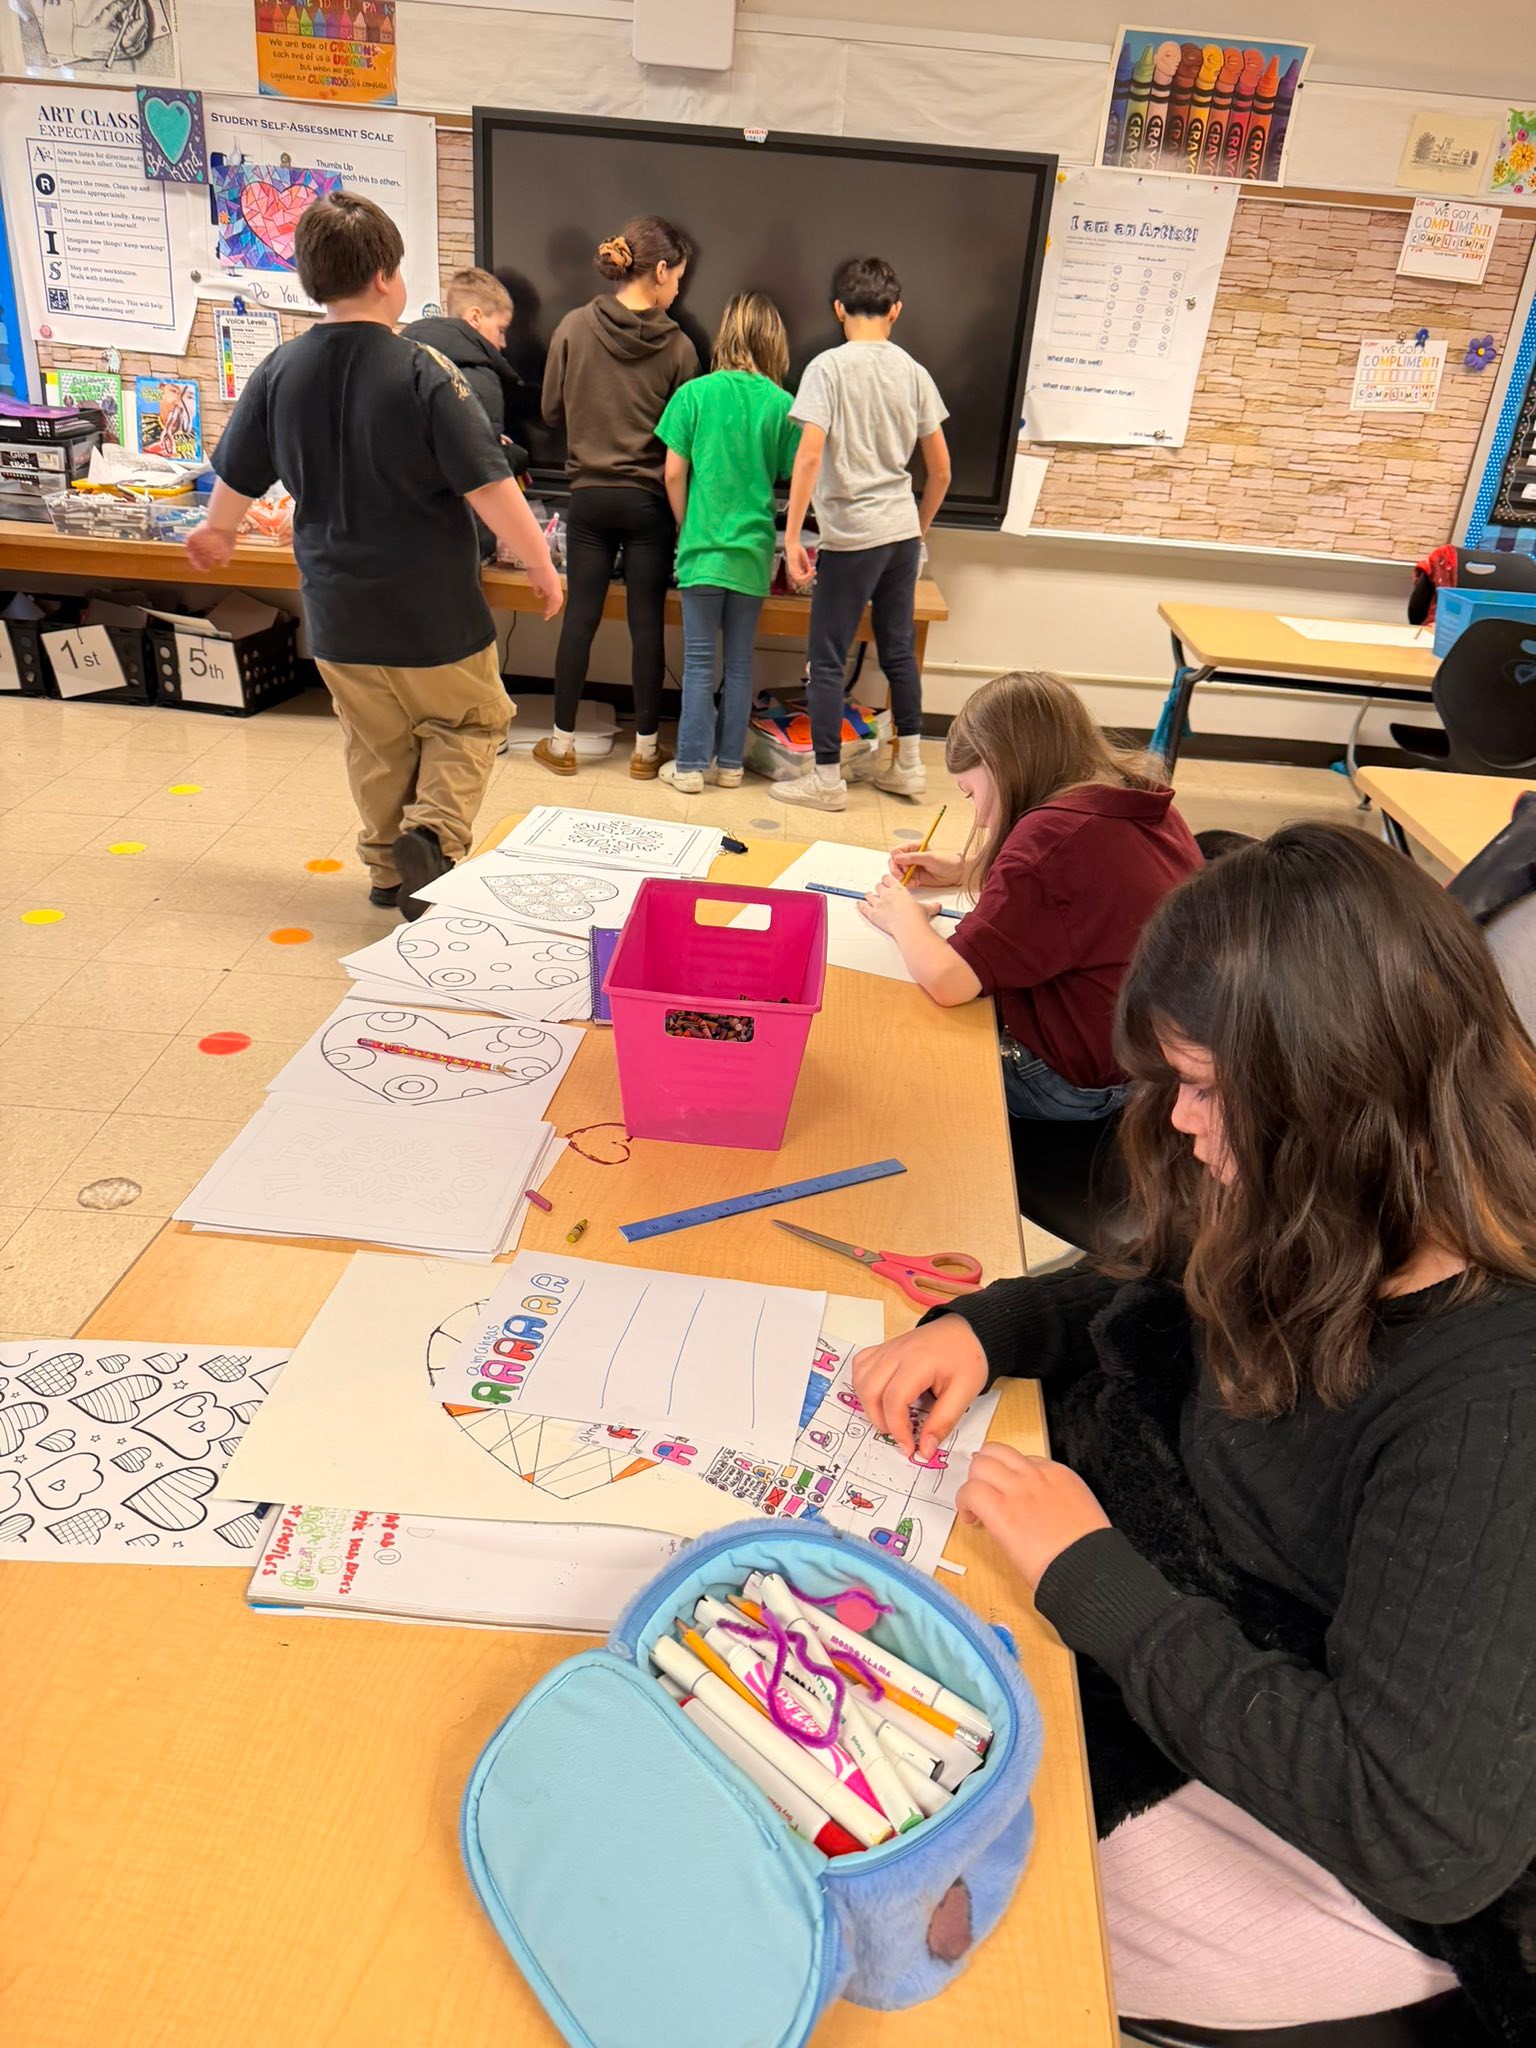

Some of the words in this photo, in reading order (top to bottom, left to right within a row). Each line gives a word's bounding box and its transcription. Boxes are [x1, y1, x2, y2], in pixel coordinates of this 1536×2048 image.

[269, 38, 282, 47] We
[301, 40, 316, 49] box
[319, 42, 327, 50] of
[306, 53, 314, 61] of
[38, 105, 75, 124] ART
[81, 108, 140, 130] CLASS
[40, 124, 142, 145] EXPECTATIONS
[316, 159, 342, 170] Thumbs
[343, 163, 354, 172] Up
[358, 174, 370, 182] this
[370, 176, 378, 184] to
[1435, 207, 1450, 217] WE
[1452, 209, 1471, 220] GOT
[1472, 212, 1479, 221] A
[1071, 215, 1080, 231] I
[1082, 220, 1109, 233] am
[1113, 223, 1137, 237] an
[1139, 222, 1199, 243] Artist!
[1415, 216, 1492, 238] COMPLIMENT!
[248, 282, 269, 299] Do
[280, 285, 298, 303] You
[1363, 355, 1440, 369] COMPLIMENT!
[10, 450, 29, 460] Glue
[60, 639, 101, 669] 1st
[190, 647, 224, 680] 5th
[911, 1686, 925, 1698] fine
